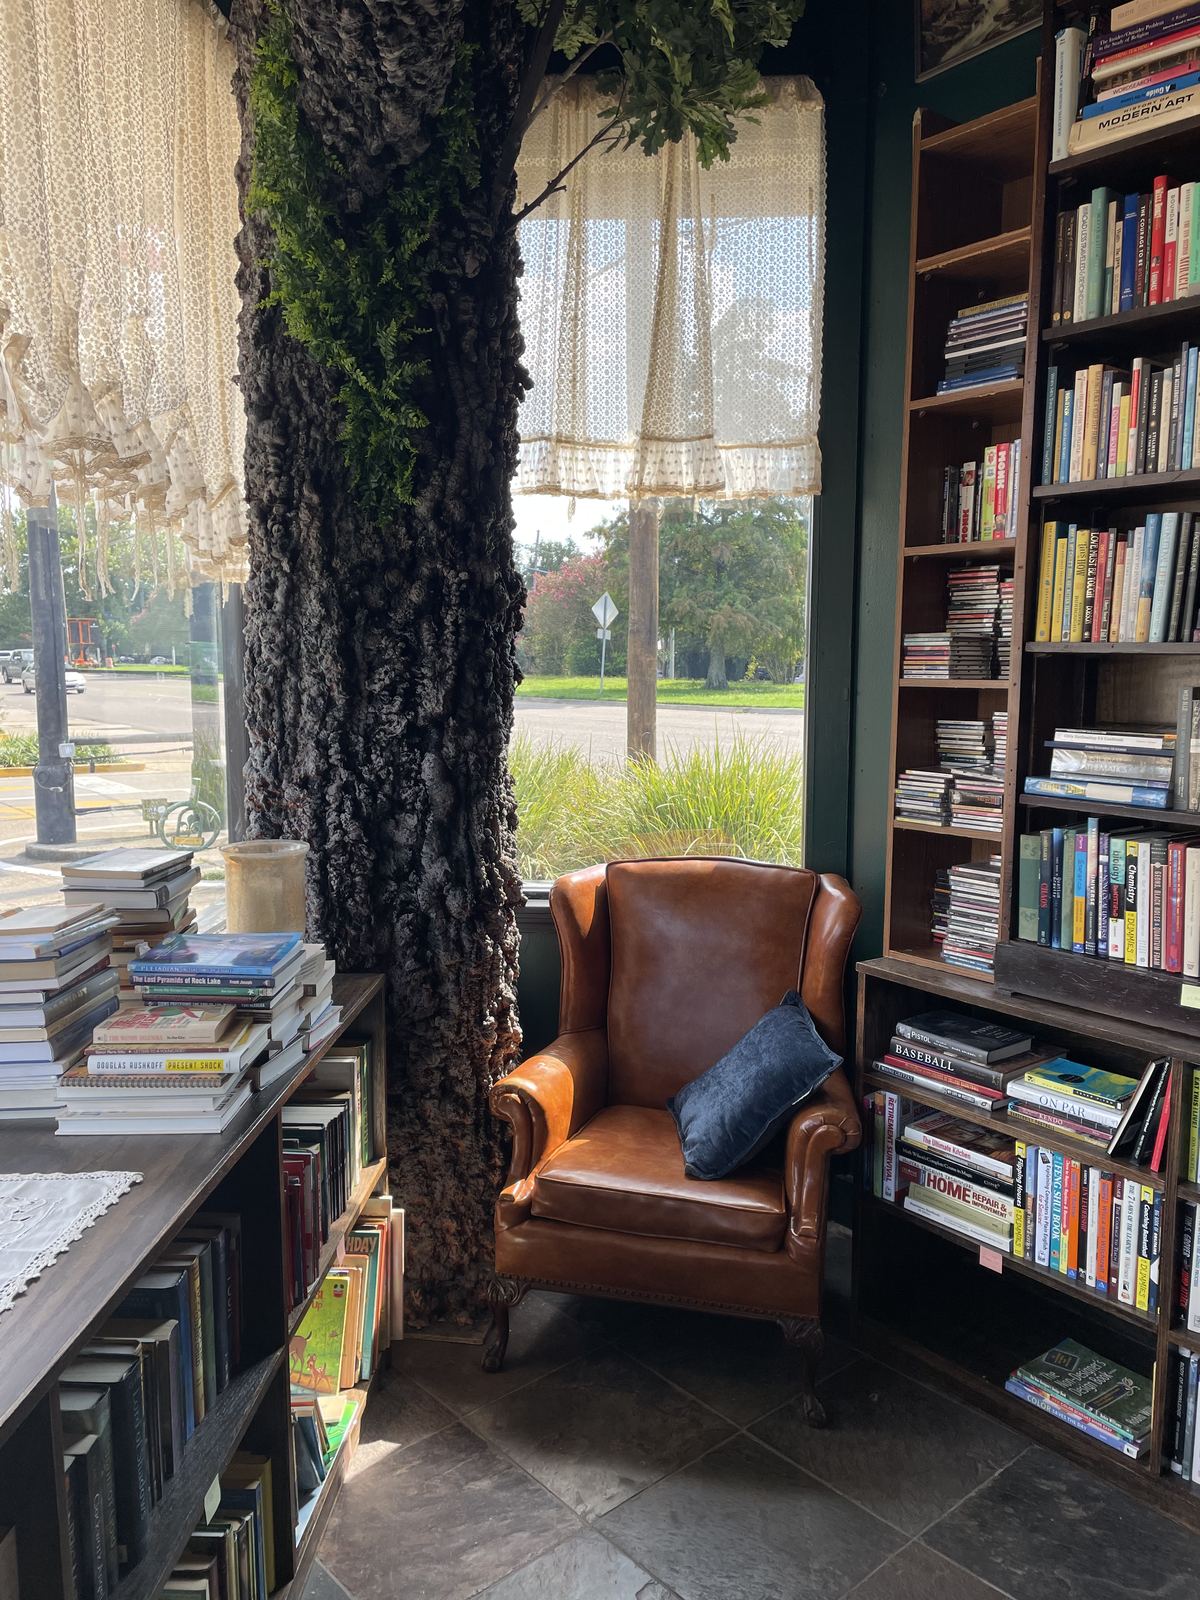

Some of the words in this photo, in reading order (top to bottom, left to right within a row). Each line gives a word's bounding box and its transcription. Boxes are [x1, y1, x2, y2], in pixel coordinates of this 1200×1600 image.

[1145, 87, 1164, 97] Guide
[1165, 84, 1170, 92] A
[1098, 104, 1161, 130] MODERN
[1165, 93, 1194, 108] ART
[1124, 100, 1156, 113] HISTORY
[1138, 249, 1144, 257] TO
[1138, 259, 1143, 267] BE
[1110, 409, 1118, 432] DON'T
[997, 451, 1006, 490] MONK
[1090, 532, 1099, 549] LOVE
[1076, 559, 1086, 576] HOW
[1089, 550, 1098, 567] MUST
[1088, 568, 1096, 576] BE
[1086, 577, 1095, 598] TOUGH
[1085, 606, 1093, 625] DOBSON
[1111, 850, 1123, 882] biology
[1127, 864, 1136, 904] Chemistry
[1153, 907, 1161, 922] HOLES
[1153, 927, 1161, 950] QUANTUM
[911, 1031, 931, 1044] PISTOL
[167, 1062, 197, 1070] PRESENT
[200, 1062, 222, 1070] SHOCK
[895, 1044, 955, 1072] BASEBALL
[1039, 1095, 1058, 1109] ON
[1062, 1103, 1085, 1118] PAR
[1039, 1113, 1063, 1125] KENDO
[931, 1138, 952, 1152] Ultimate
[952, 1146, 971, 1159] Kitchen
[1016, 1158, 1024, 1183] Flipping
[1054, 1164, 1062, 1188] FENG
[927, 1172, 971, 1204] HOME
[972, 1192, 999, 1210] REPAIR
[1000, 1203, 1007, 1212] &
[972, 1200, 1007, 1219] IMPROVEMENT
[1052, 1190, 1061, 1212] SHUI
[1142, 1204, 1150, 1229] Coaching
[1052, 1214, 1060, 1241] BOOK
[346, 1237, 378, 1253] HDAY
[1183, 1234, 1191, 1257] GROVER
[1139, 1264, 1147, 1298] DUMMIES
[1181, 1271, 1190, 1286] JUMP
[1068, 1380, 1098, 1397] Design
[1089, 1373, 1114, 1390] Book
[1026, 1394, 1052, 1413] COLOR
[1052, 1407, 1067, 1420] SAVES
[1067, 1416, 1078, 1425] THE
[1077, 1420, 1087, 1431] DAY
